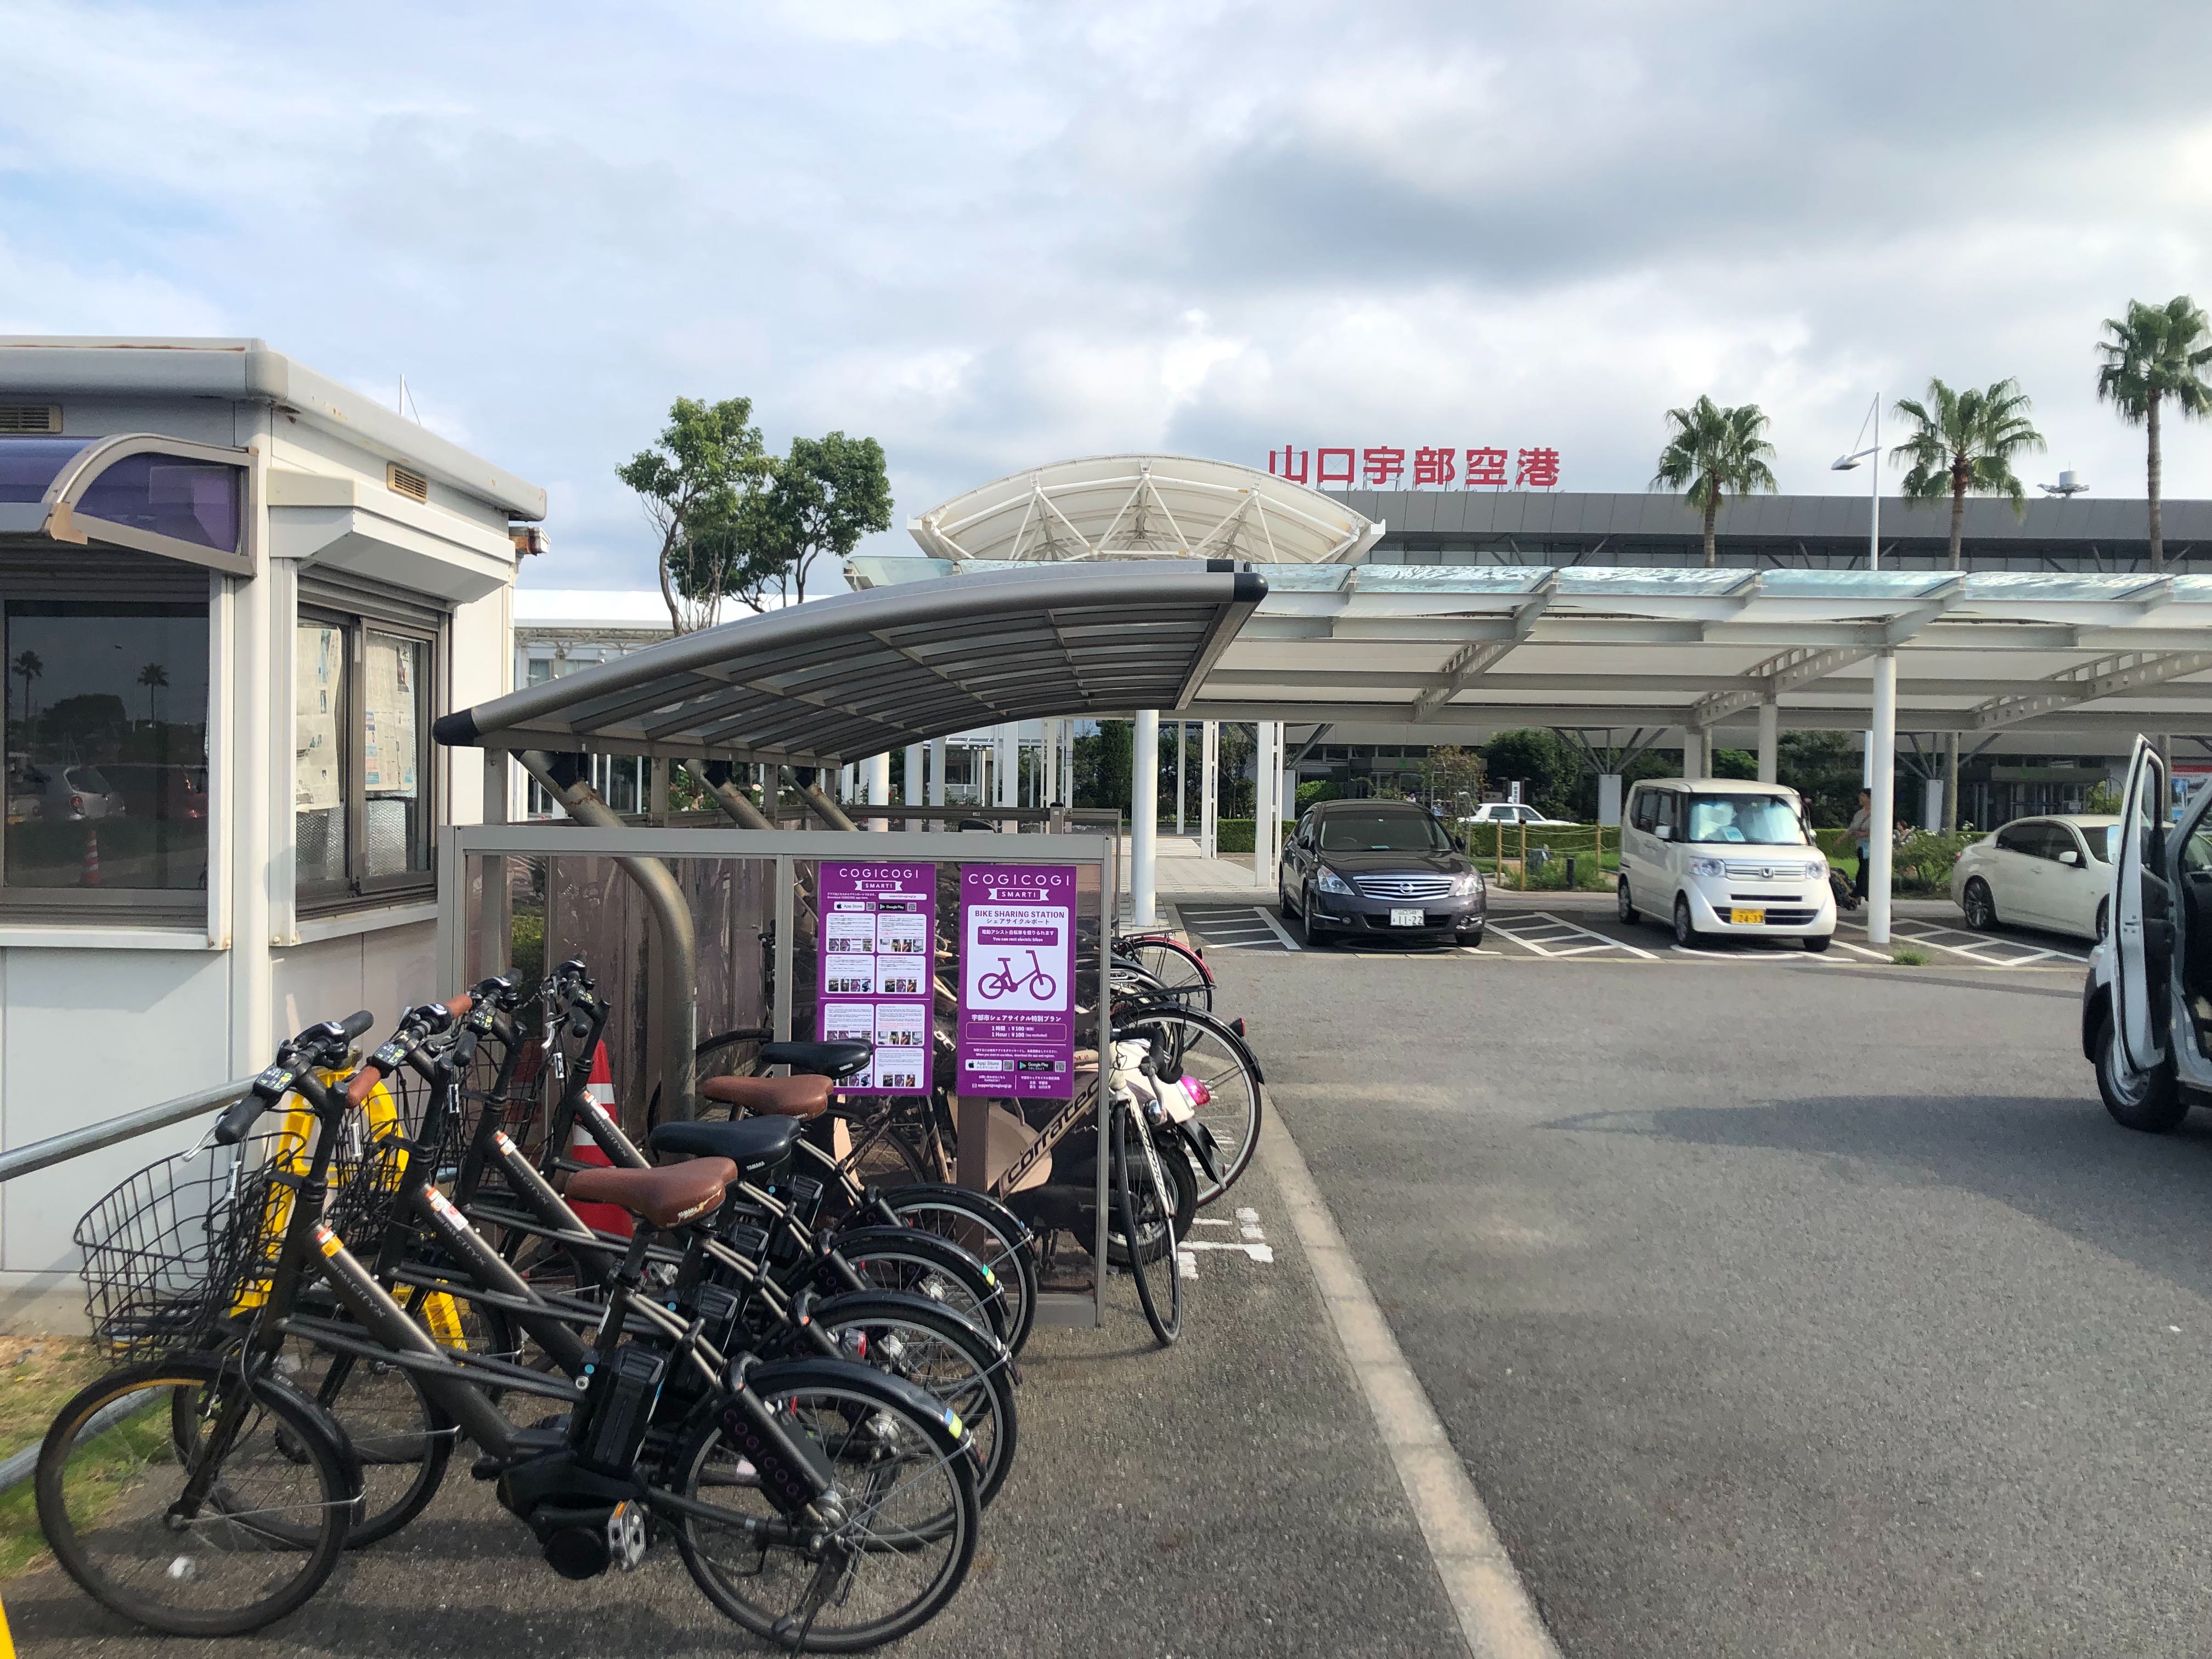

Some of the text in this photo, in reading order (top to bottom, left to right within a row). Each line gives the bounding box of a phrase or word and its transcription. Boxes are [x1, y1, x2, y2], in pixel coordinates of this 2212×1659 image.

[1268, 444, 1561, 486] 山口宇部空港
[839, 868, 918, 879] COGICOGI
[968, 873, 1070, 886] COGICOGI
[746, 1161, 765, 1170] YAMAHA
